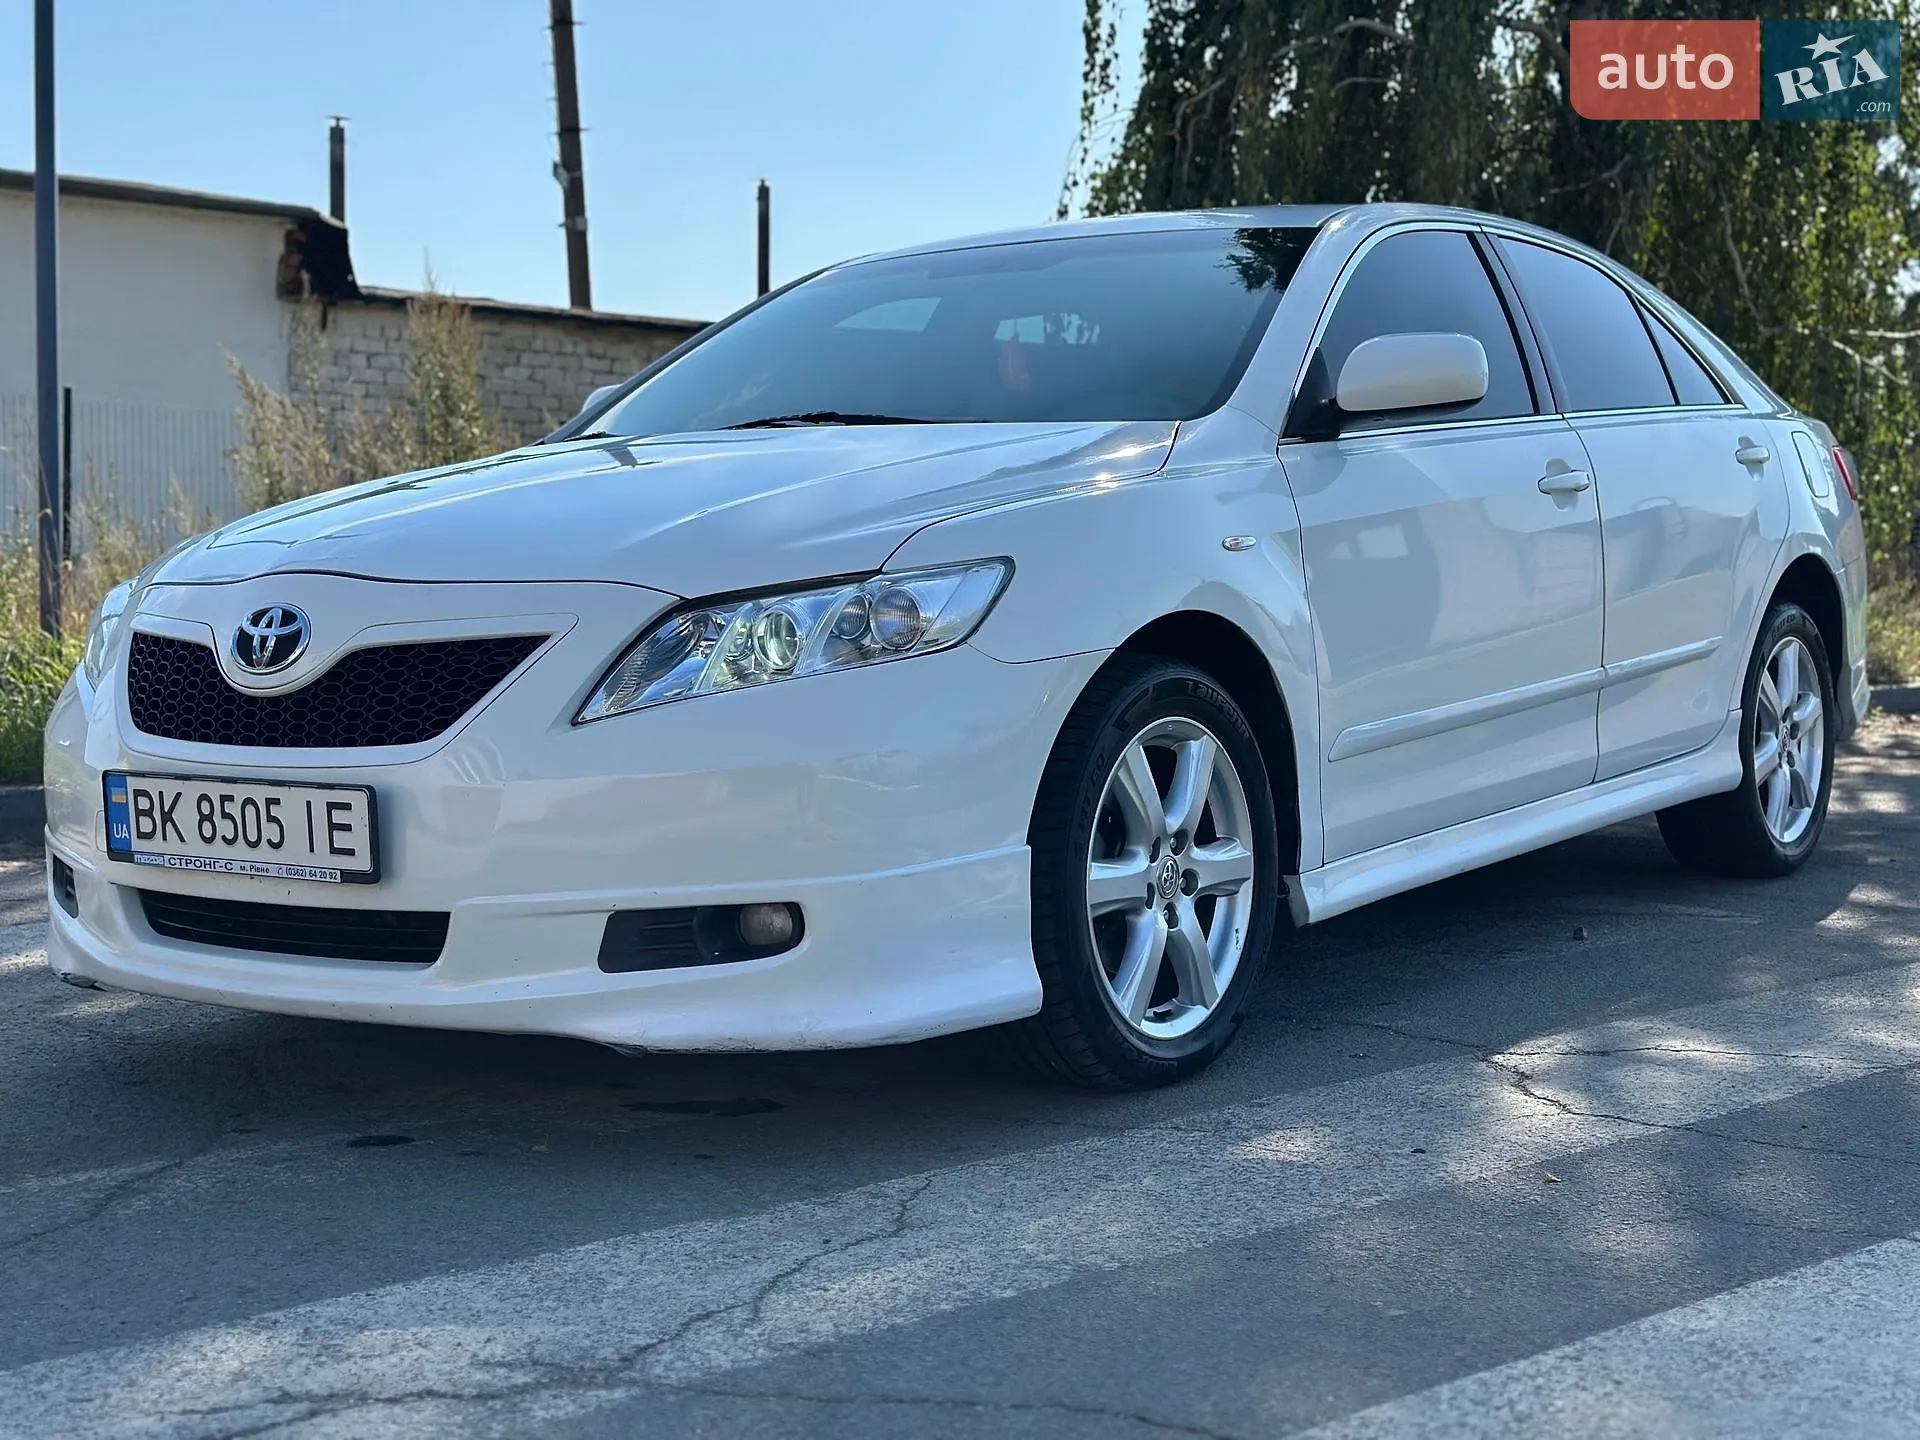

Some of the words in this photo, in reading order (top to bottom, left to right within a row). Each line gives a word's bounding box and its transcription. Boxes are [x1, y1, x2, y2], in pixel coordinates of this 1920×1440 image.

[132, 788, 188, 843] BK
[196, 793, 286, 850] 8505
[305, 799, 356, 857] IE
[113, 823, 130, 839] UA
[308, 869, 318, 878] 64
[318, 870, 328, 879] 20
[328, 871, 338, 880] 92
